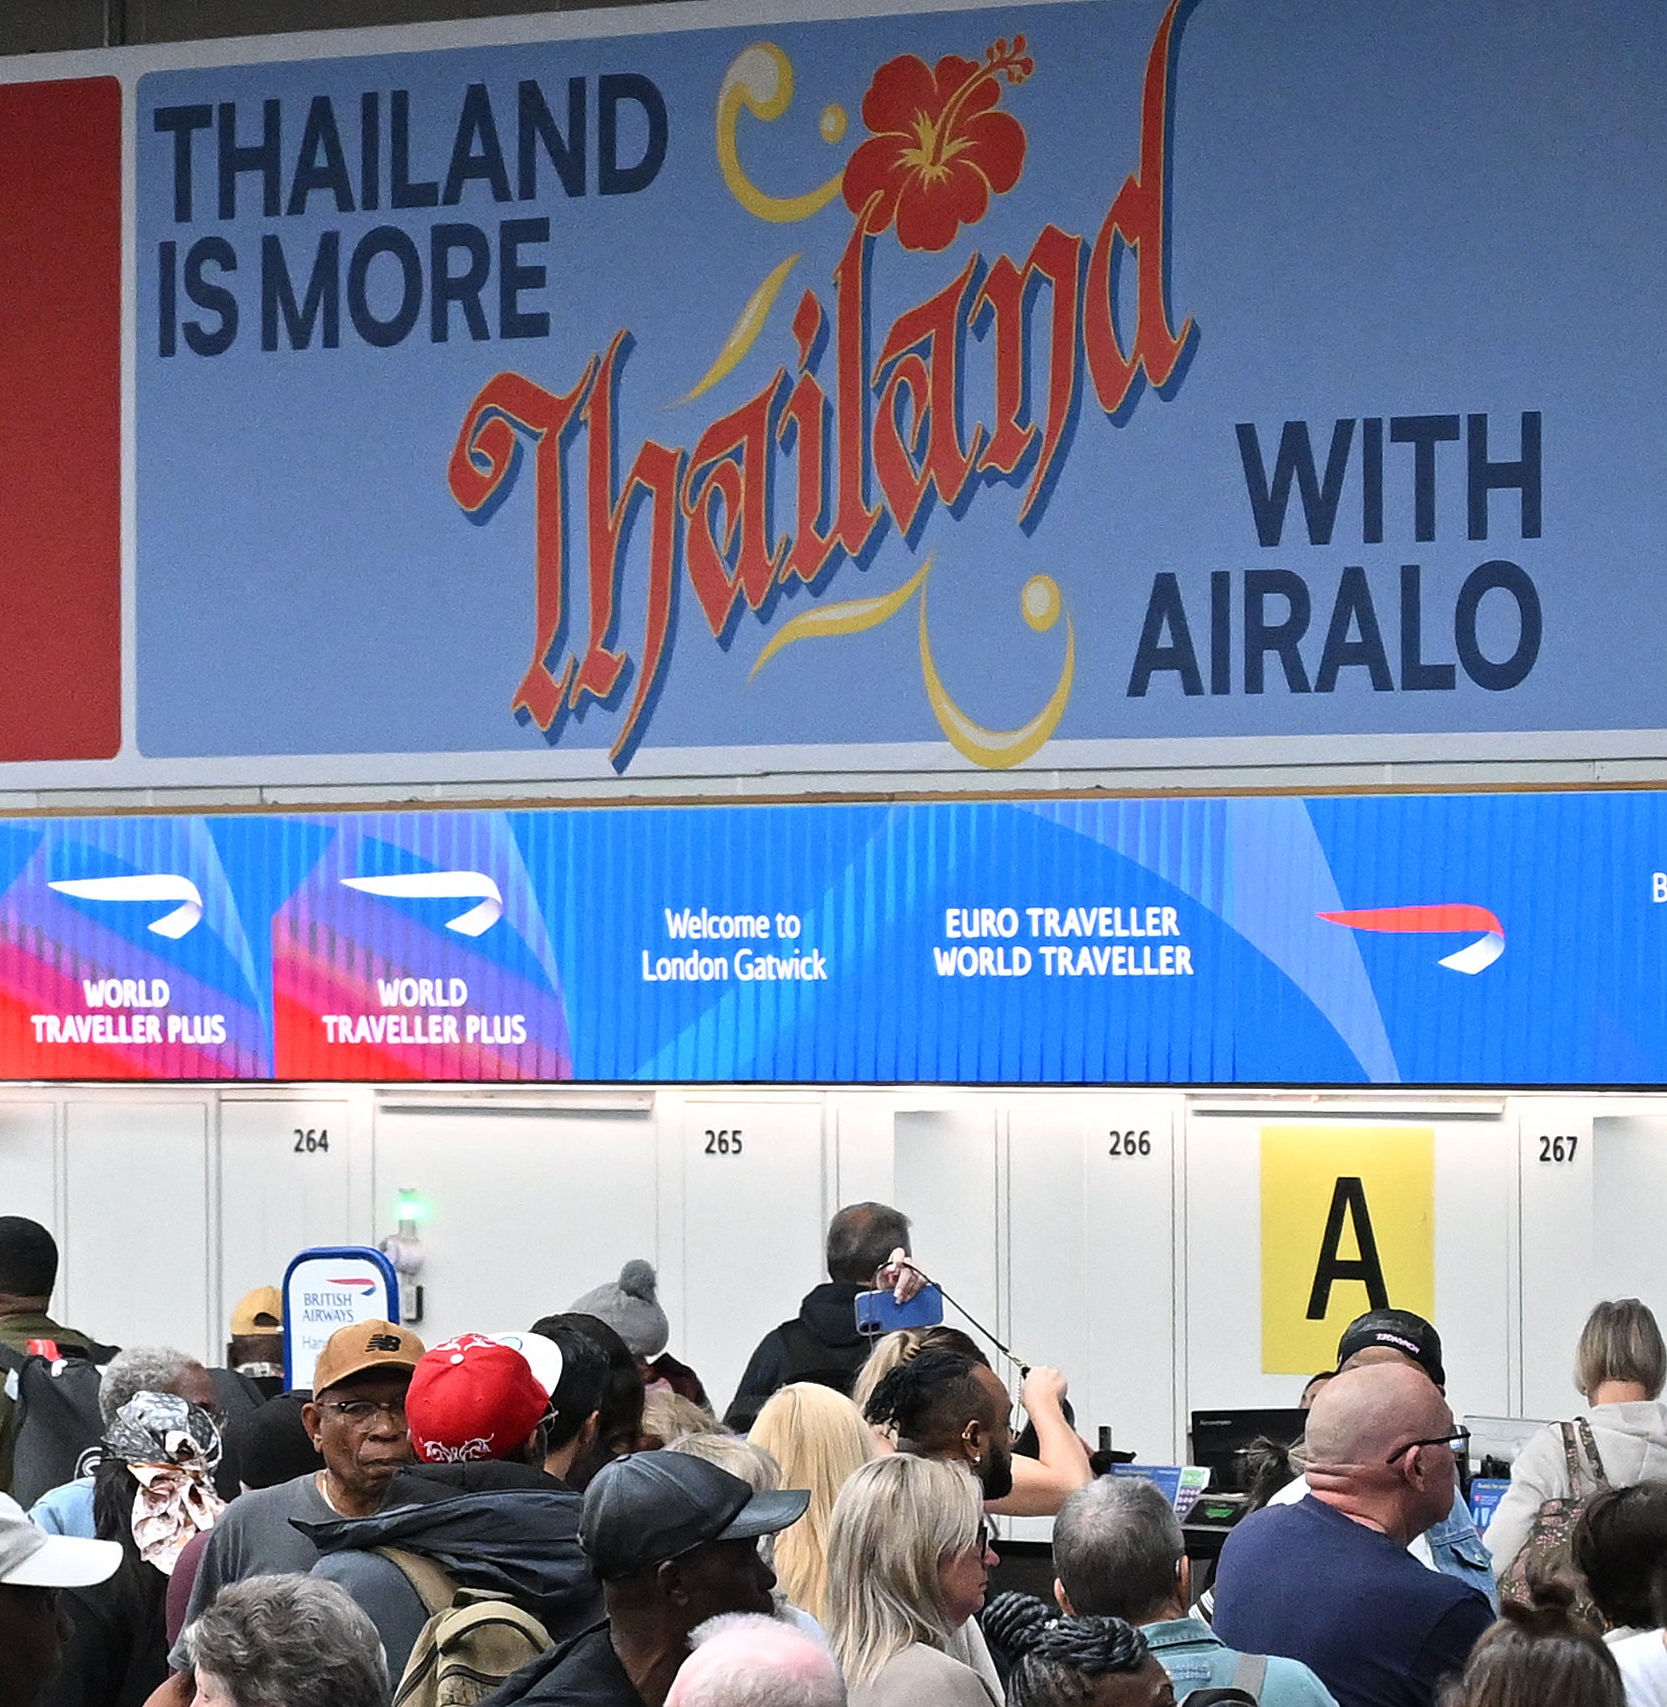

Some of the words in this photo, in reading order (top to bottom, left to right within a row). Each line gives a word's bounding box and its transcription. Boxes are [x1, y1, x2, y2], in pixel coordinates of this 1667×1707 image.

[154, 72, 667, 225] THAILAND
[159, 235, 238, 358] IS
[260, 220, 551, 353] MORE
[447, 0, 1204, 775] Thailand
[1236, 410, 1544, 548] WITH
[1128, 559, 1544, 697] AIRALO
[666, 909, 768, 940] Welcome
[775, 909, 801, 940] to
[946, 908, 1018, 938] EURO
[1029, 908, 1179, 938] TRAVELLER
[643, 948, 726, 982] London
[734, 948, 827, 982] Gatwick
[934, 946, 1031, 976] WORLD
[1039, 946, 1193, 976] TRAVELLER
[83, 980, 170, 1008] WORLD
[378, 979, 467, 1008] WORLD
[31, 1015, 162, 1044] TRAVELLER
[168, 1015, 226, 1044] PLUS
[322, 1015, 457, 1044] TRAVELLER
[466, 1015, 527, 1044] PLUS
[293, 1128, 329, 1154] 264
[704, 1129, 743, 1156] 265
[1108, 1130, 1151, 1157] 266
[1539, 1136, 1579, 1162] 267
[1306, 1176, 1390, 1320] A
[303, 1292, 353, 1307] BRITISH
[302, 1309, 355, 1323] AIRWAYS
